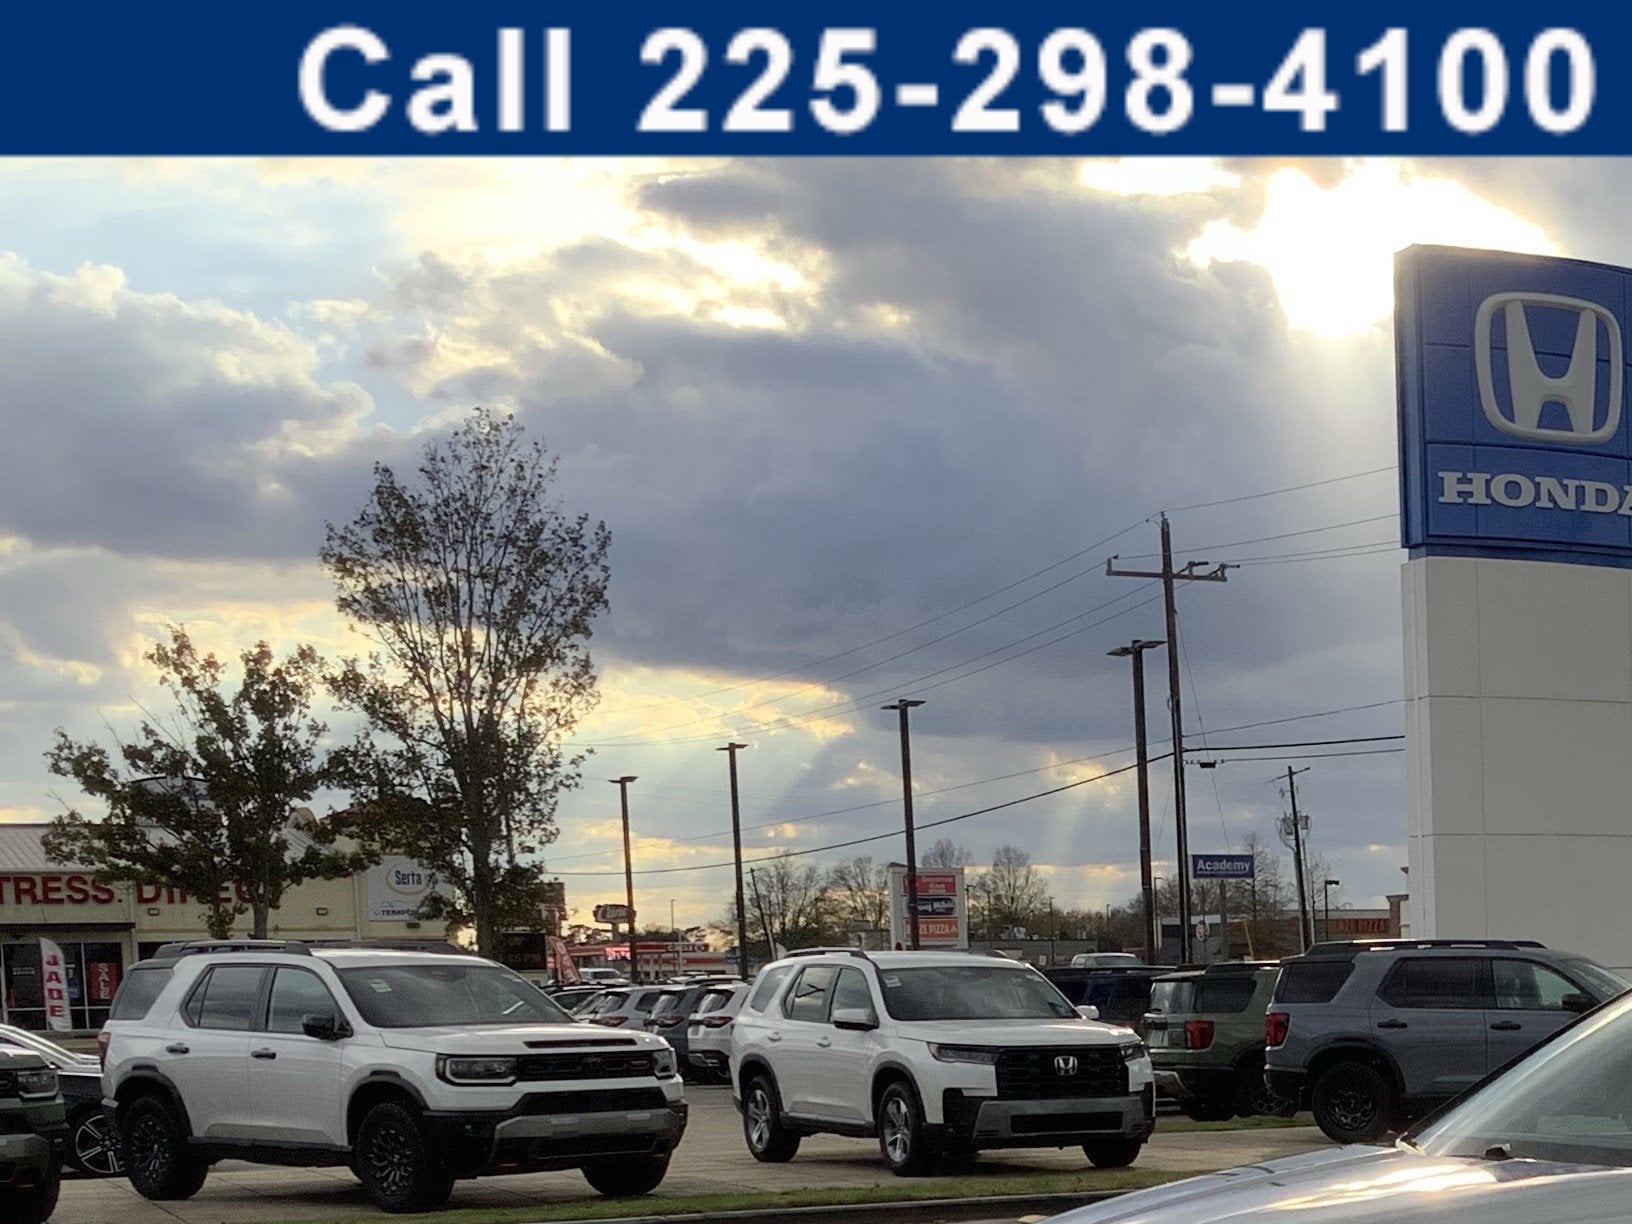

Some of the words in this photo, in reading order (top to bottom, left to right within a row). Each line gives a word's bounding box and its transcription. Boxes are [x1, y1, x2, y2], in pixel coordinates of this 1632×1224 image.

[1197, 859, 1251, 874] Academy
[395, 870, 422, 885] Serta
[929, 924, 950, 934] PIZZA
[45, 955, 64, 1017] JADE
[98, 963, 111, 999] SALE
